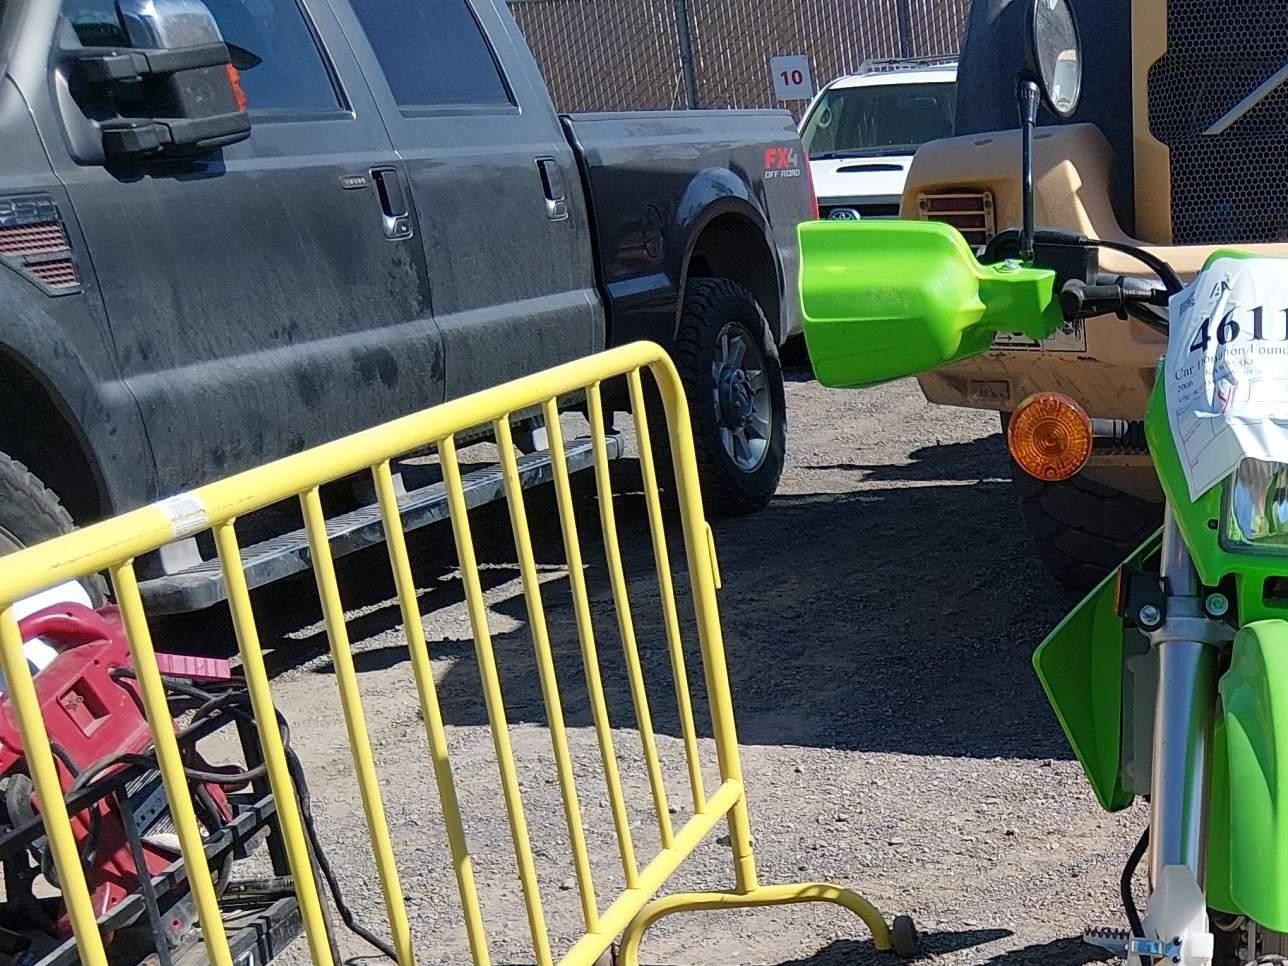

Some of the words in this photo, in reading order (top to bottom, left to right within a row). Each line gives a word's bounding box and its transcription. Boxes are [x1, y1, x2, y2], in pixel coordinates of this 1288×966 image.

[780, 70, 803, 86] 10
[764, 147, 798, 169] FX4
[765, 170, 779, 179] OFF
[781, 169, 801, 178] ROAD
